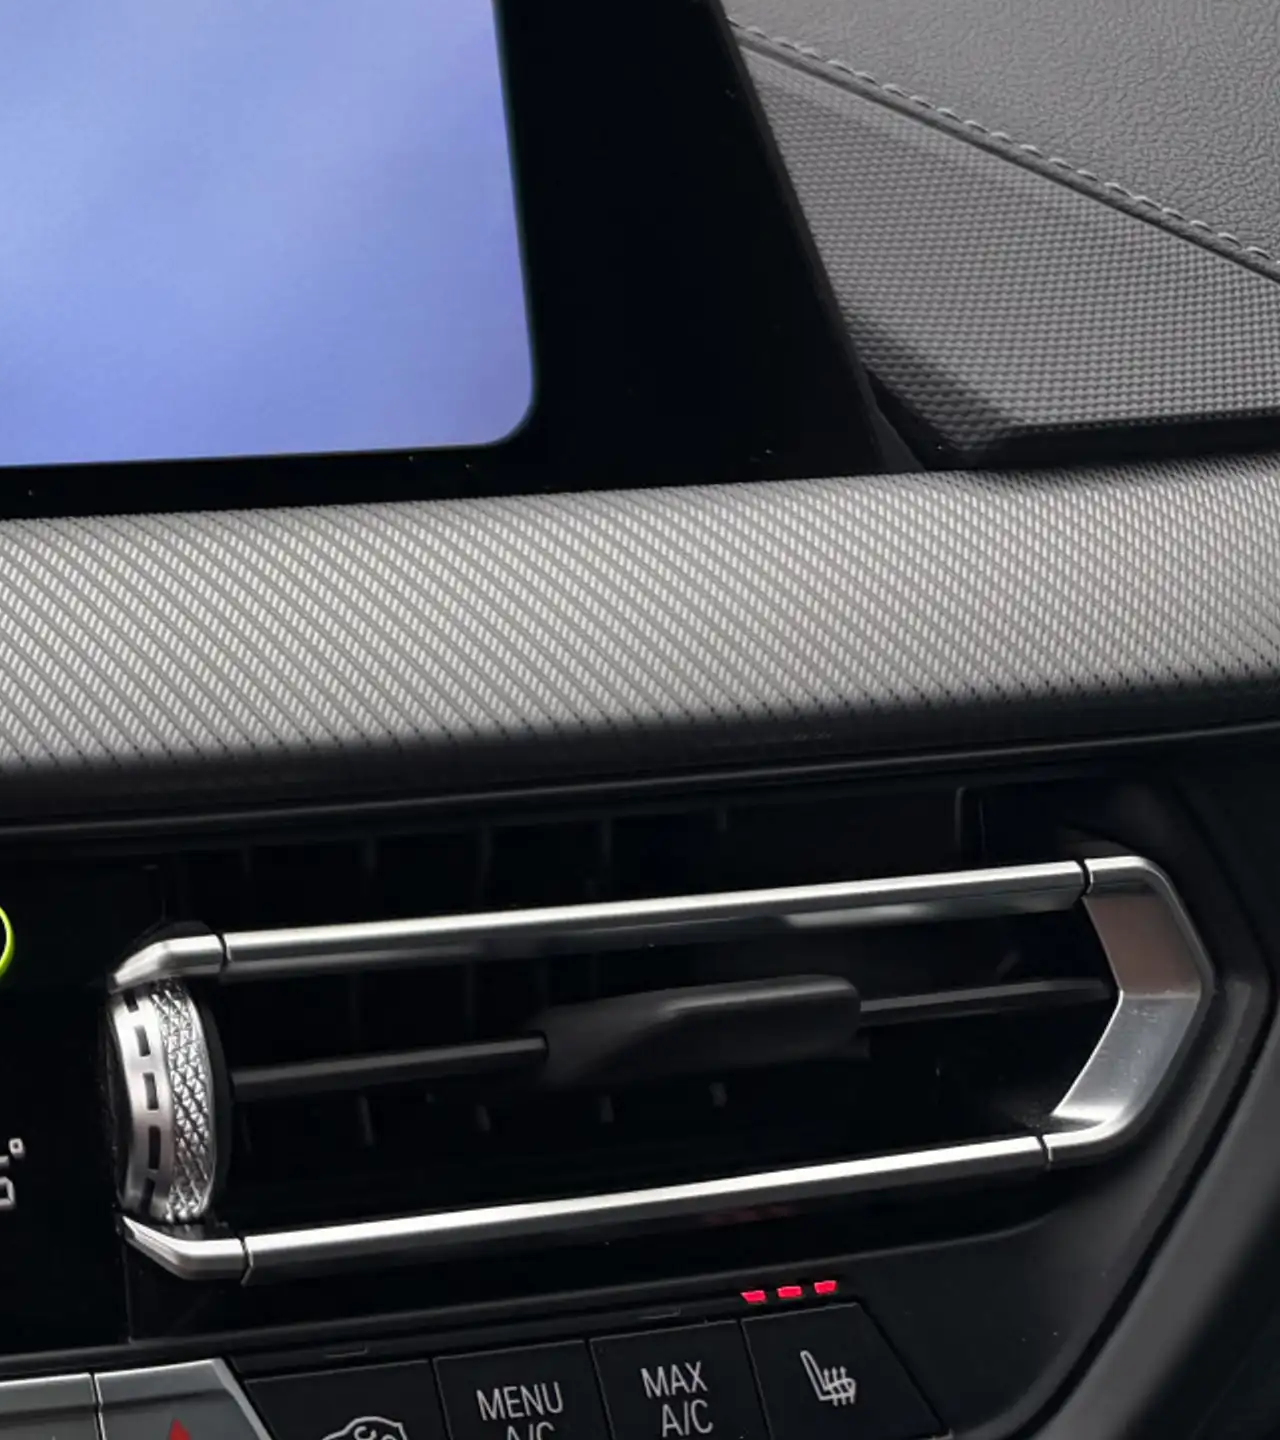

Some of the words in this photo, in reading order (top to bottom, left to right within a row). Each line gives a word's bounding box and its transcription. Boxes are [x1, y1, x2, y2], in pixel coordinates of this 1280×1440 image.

[640, 1360, 709, 1399] MAX
[475, 1381, 565, 1421] MENU
[661, 1398, 715, 1438] A/C
